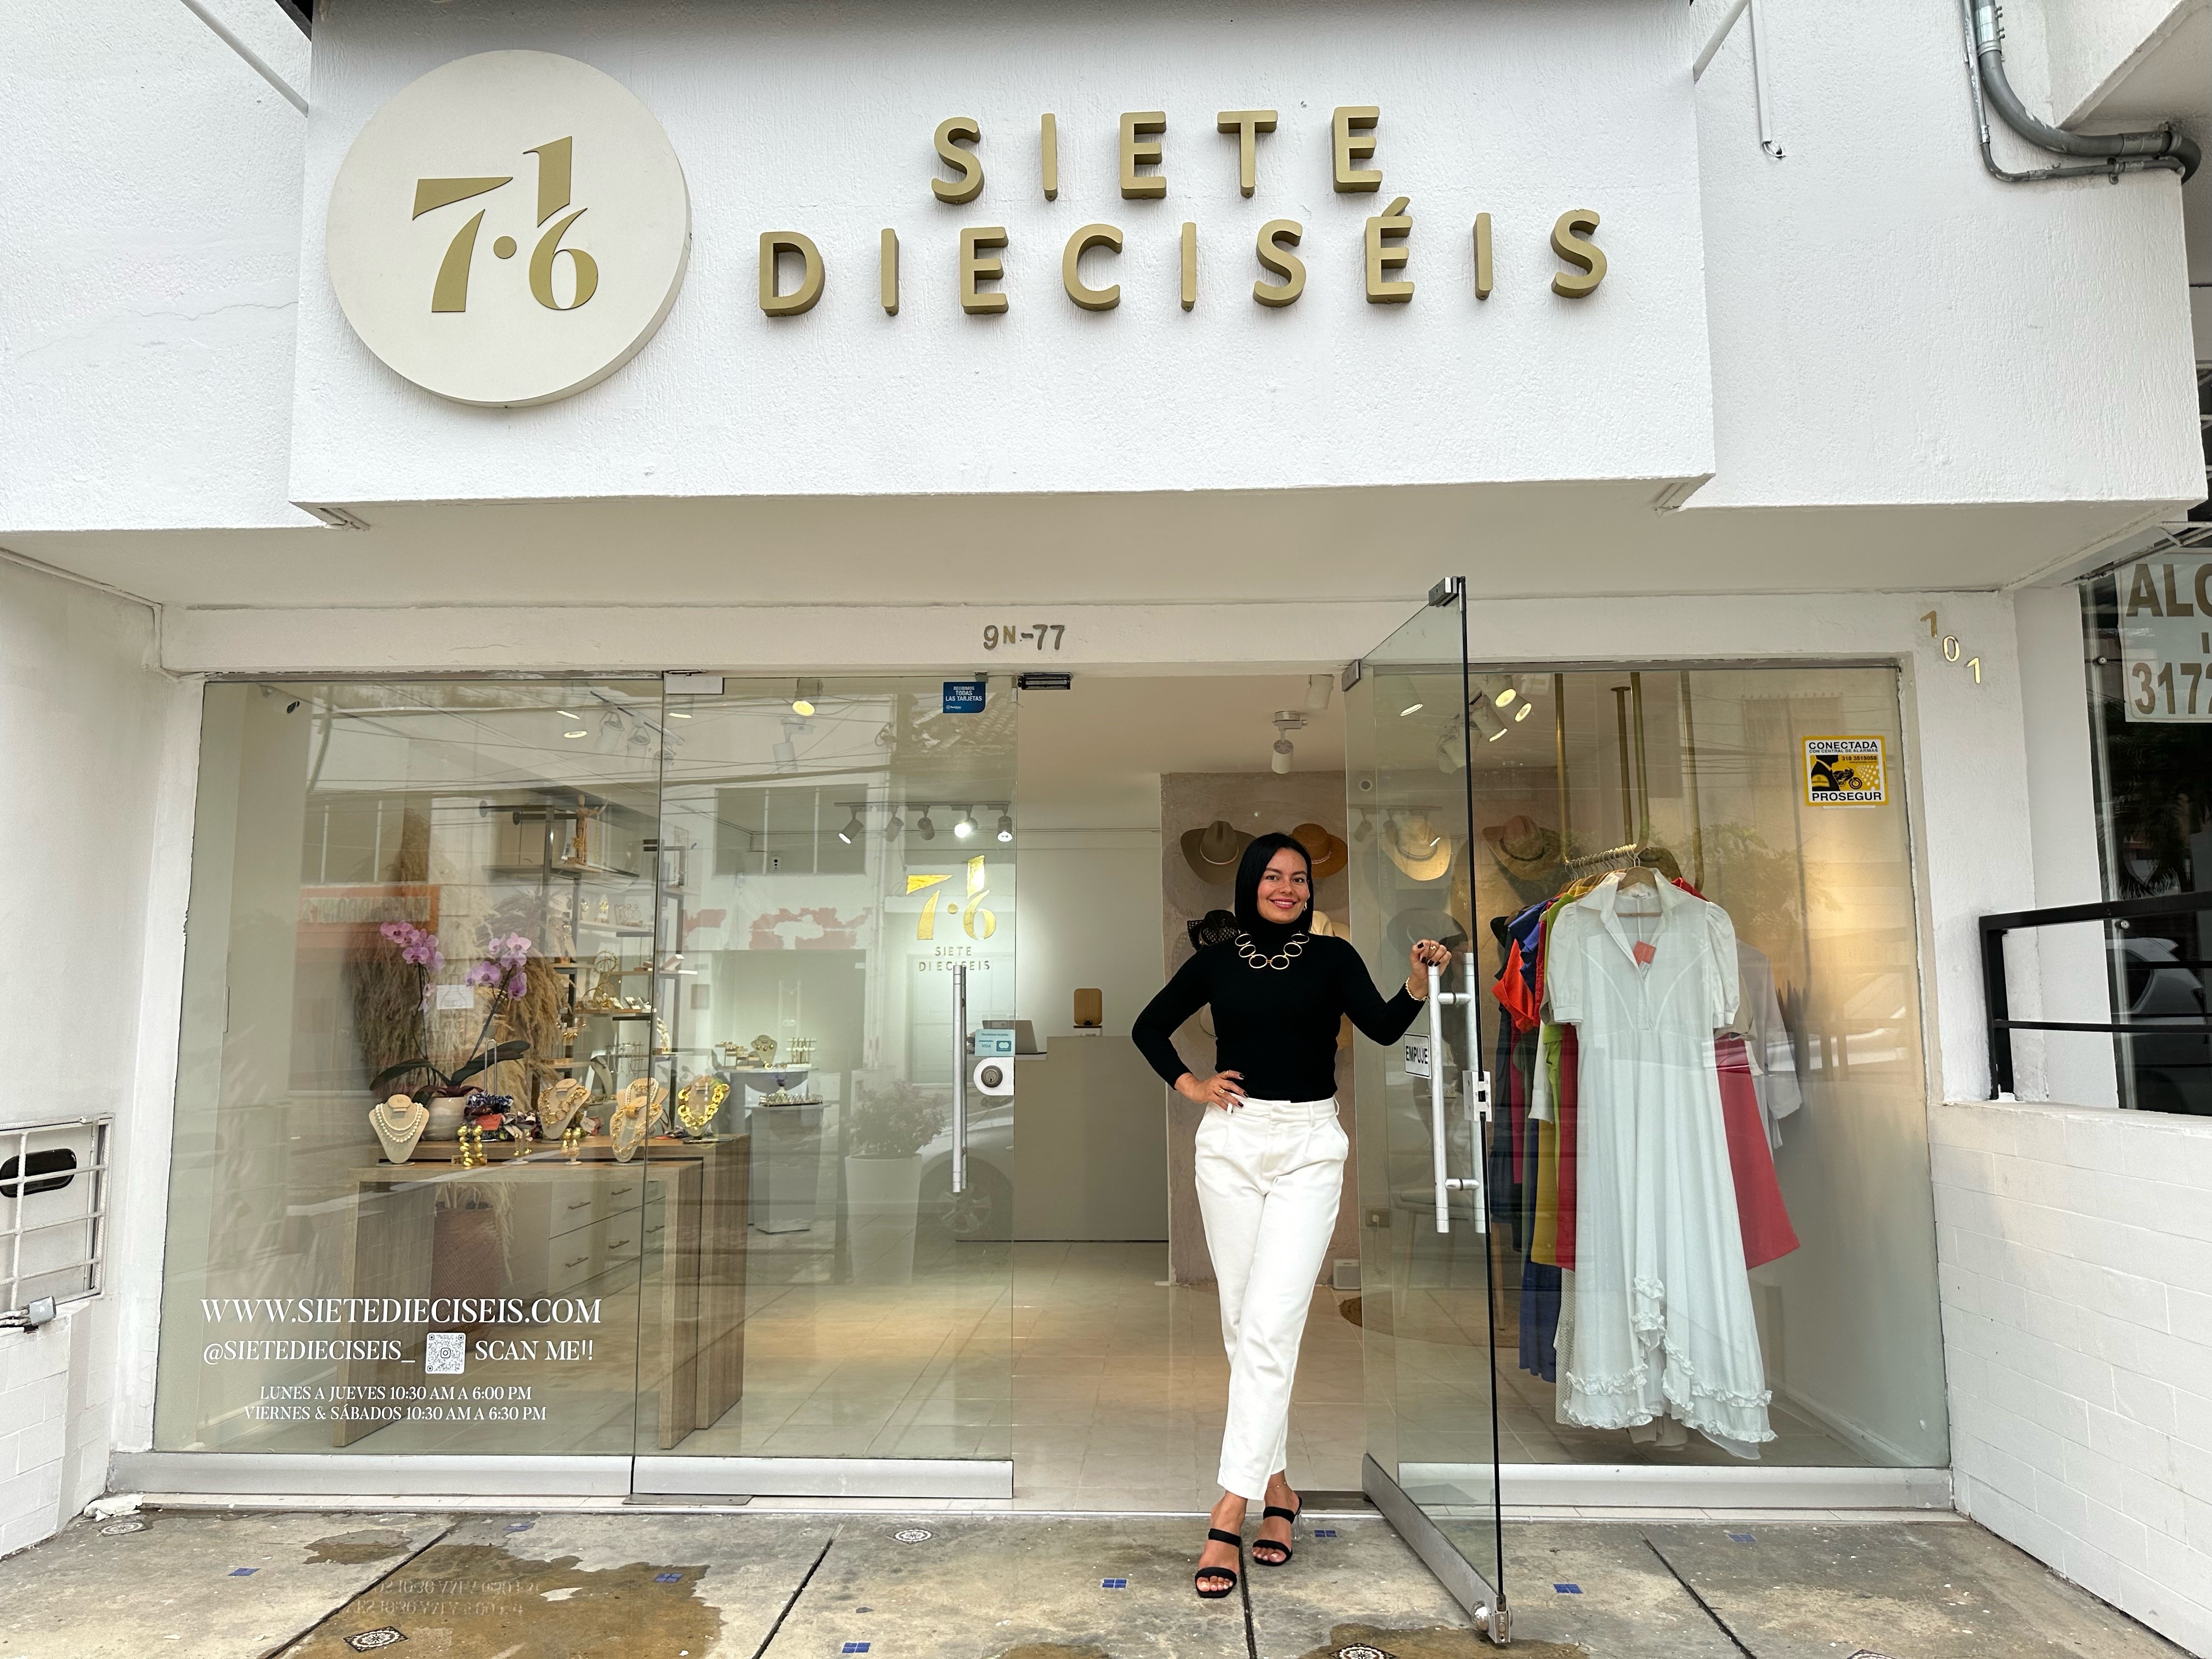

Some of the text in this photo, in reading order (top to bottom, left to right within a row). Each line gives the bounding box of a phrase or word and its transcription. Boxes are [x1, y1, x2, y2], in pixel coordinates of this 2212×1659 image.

[930, 106, 1383, 205] SIETE
[759, 196, 1607, 317] DIECISÉIS
[2132, 662, 2212, 714] 317
[1812, 792, 1881, 801] PROSEGUR
[935, 946, 972, 956] SIETE
[1406, 1046, 1428, 1064] EMPUJE
[200, 1297, 602, 1324] WWW.SIETEDIECISEIS.COM
[475, 1340, 539, 1361] SCAN
[260, 1386, 532, 1402] LUNES A JUEVES 10:30 AM A 6:00 PM
[244, 1403, 546, 1420] VIERNES & SÁBADOS 10:30 AM A 6:30 PM
